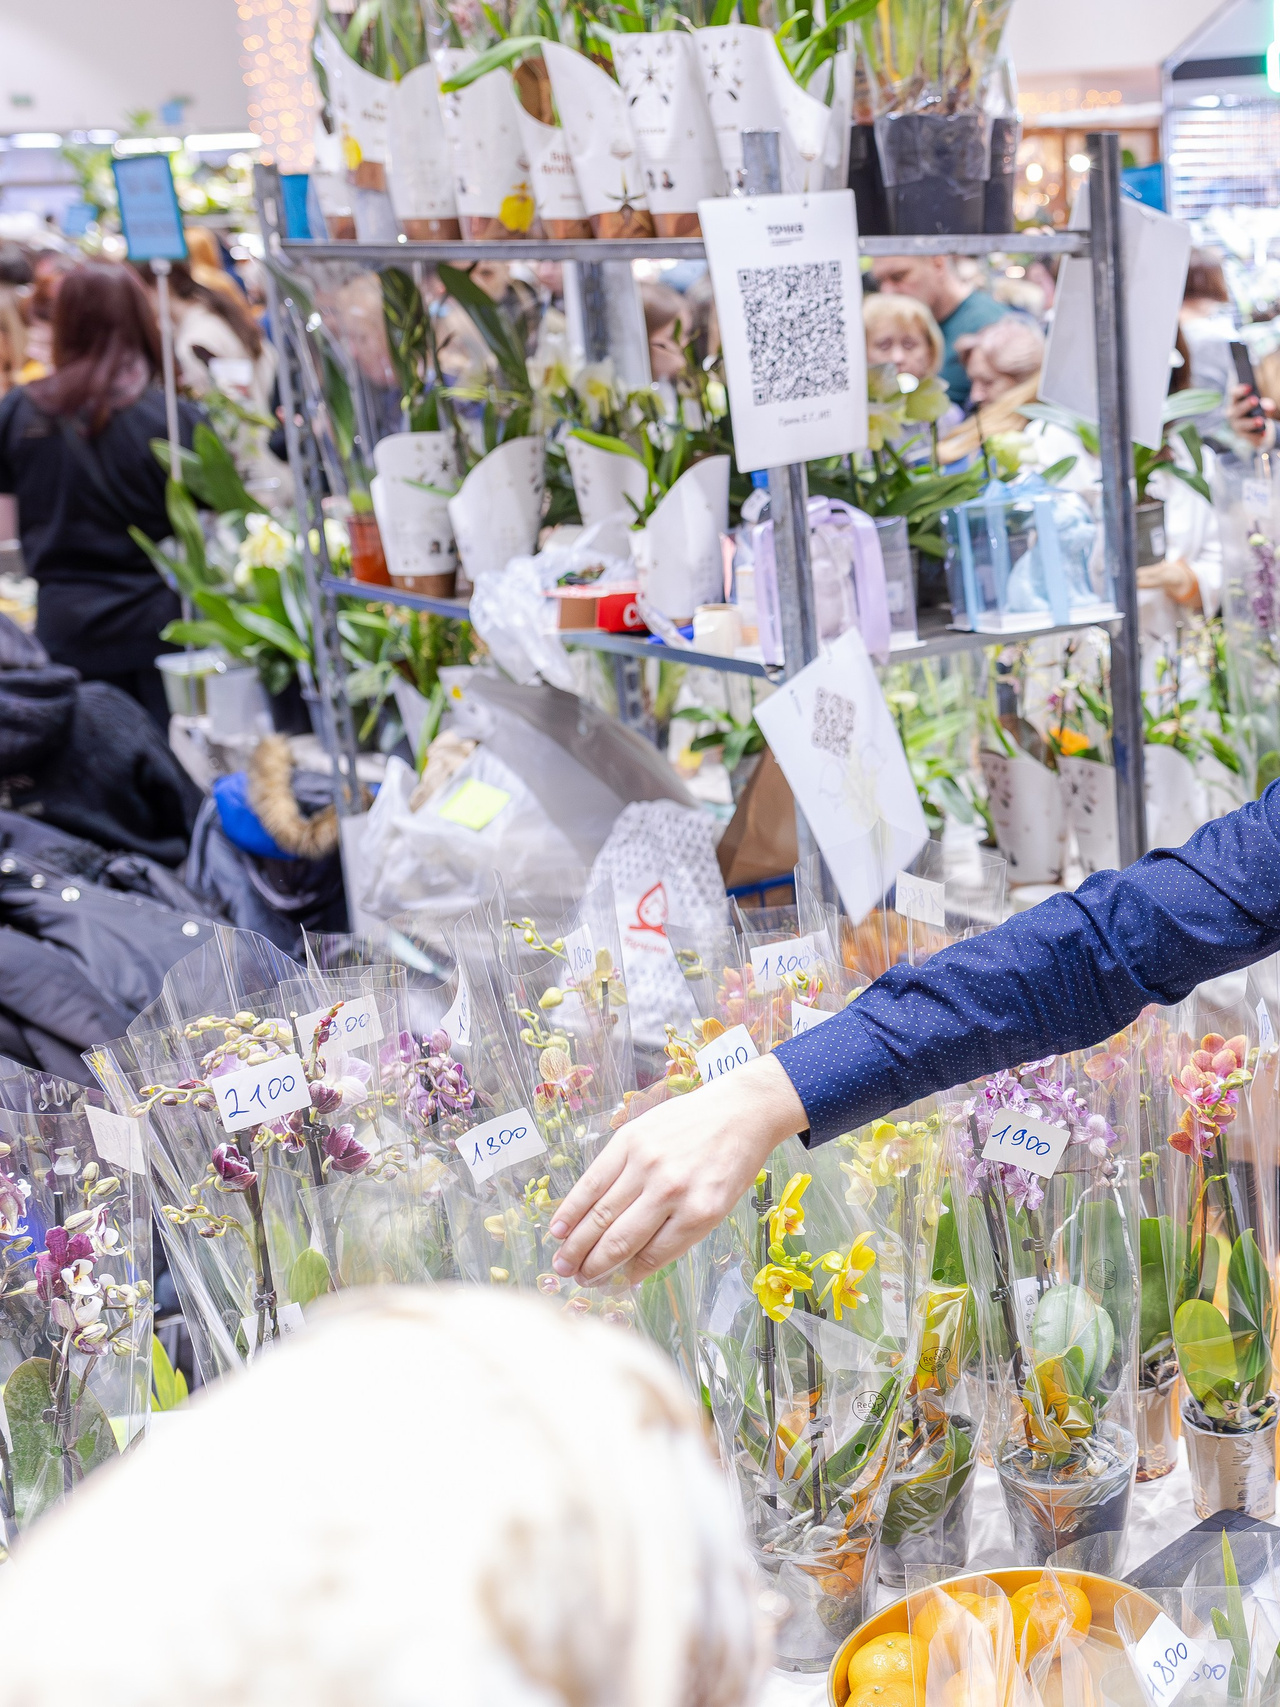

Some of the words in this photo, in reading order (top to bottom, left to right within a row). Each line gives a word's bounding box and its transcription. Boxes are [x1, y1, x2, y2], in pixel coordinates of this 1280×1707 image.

[758, 954, 810, 981] 1800
[224, 1074, 296, 1119] 2100
[471, 1126, 528, 1166] 1800
[991, 1124, 1051, 1156] 1900
[1146, 1642, 1188, 1698] 1800
